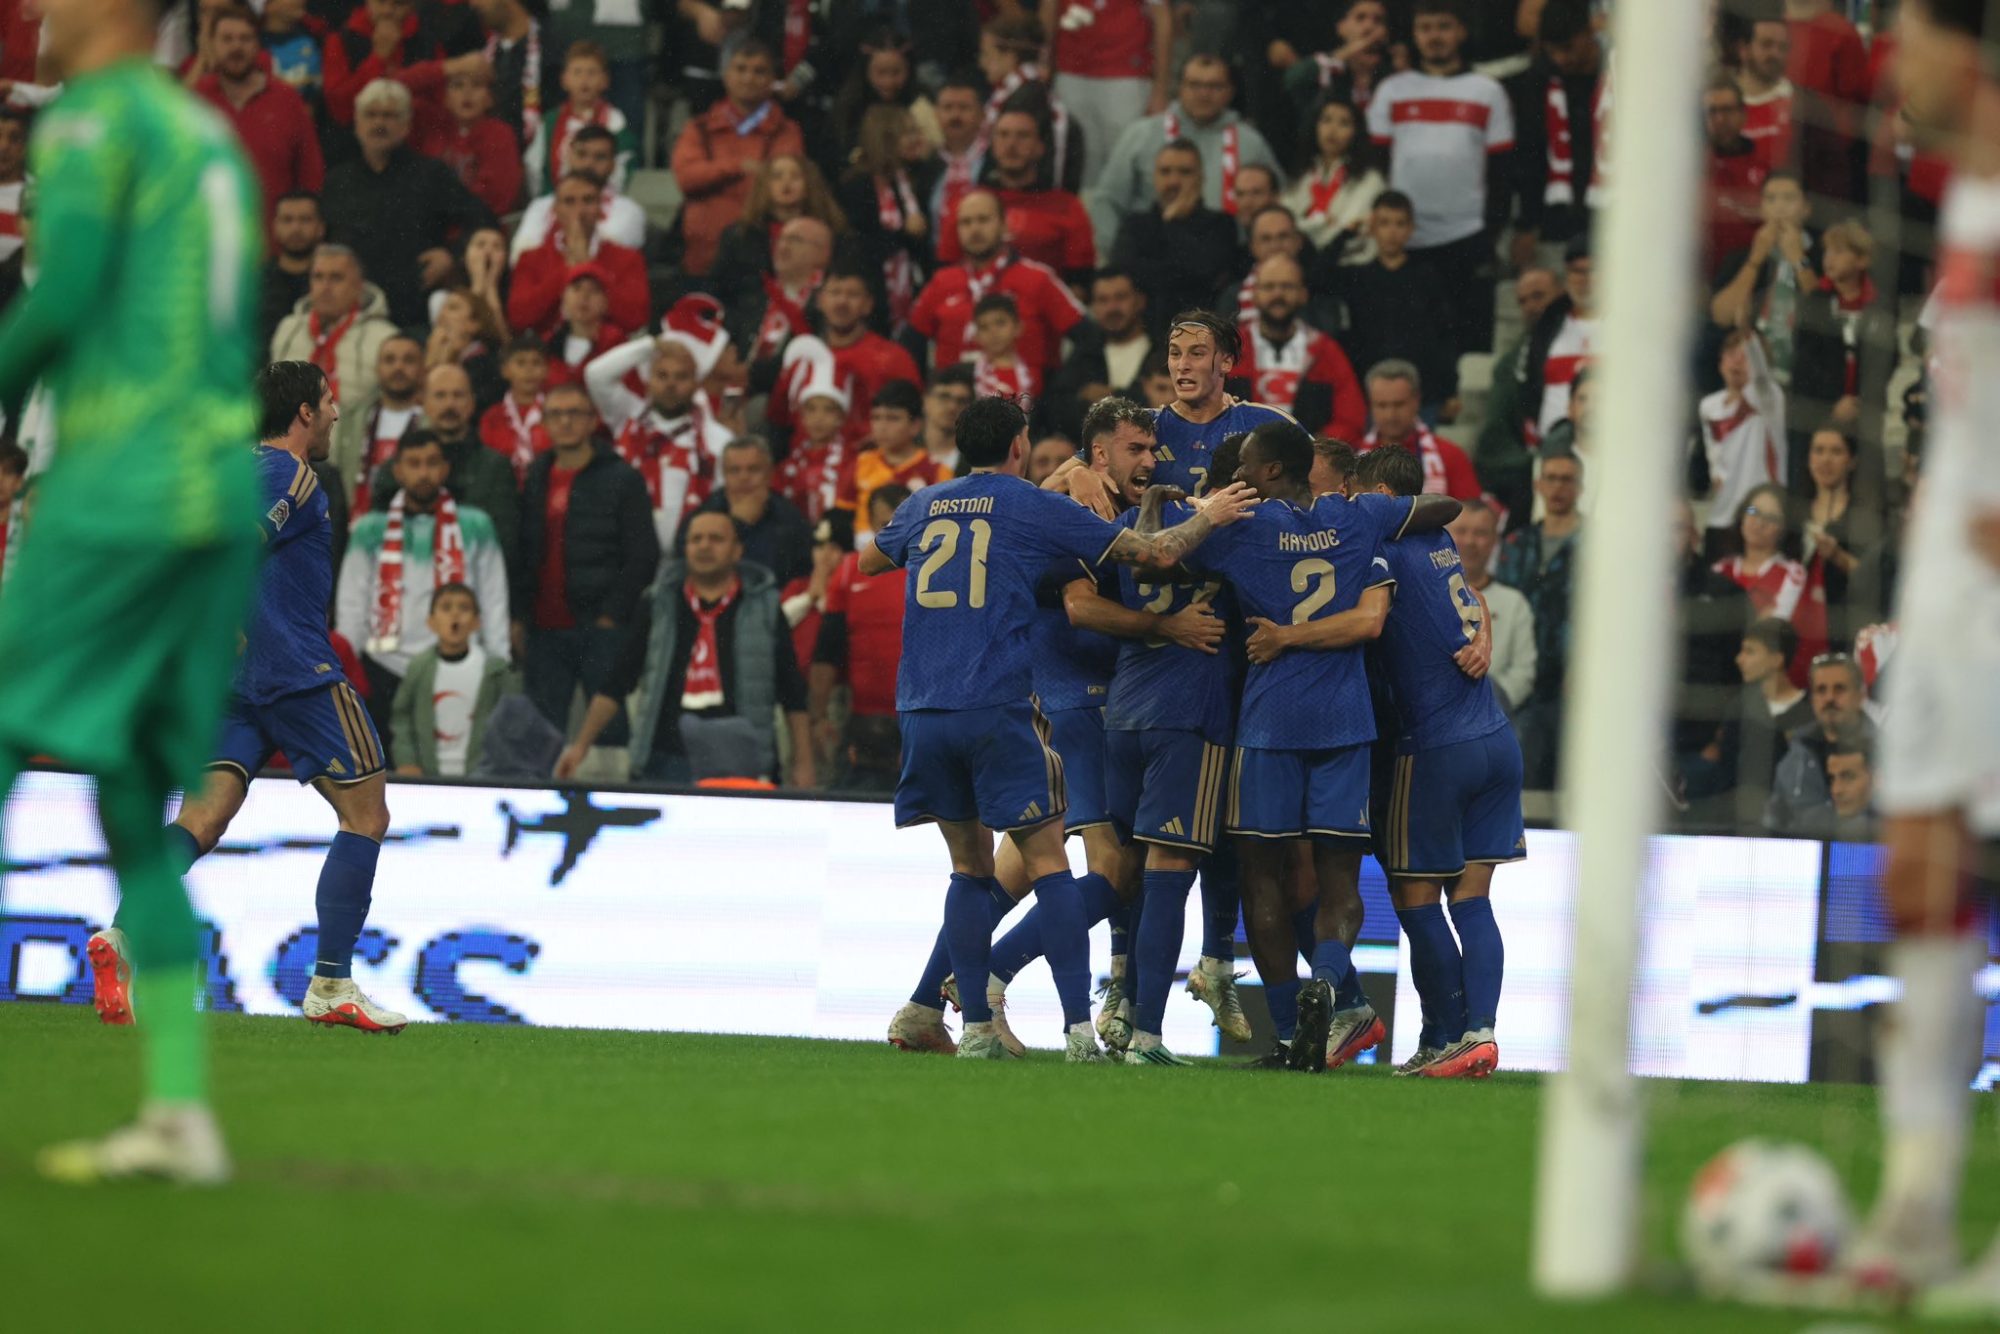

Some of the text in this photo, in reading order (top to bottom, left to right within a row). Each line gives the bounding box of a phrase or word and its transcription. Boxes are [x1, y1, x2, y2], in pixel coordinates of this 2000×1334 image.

[928, 496, 994, 516] BASTONI
[1279, 529, 1340, 552] KAYODE
[916, 518, 991, 609] 21
[1290, 558, 1336, 625] 2
